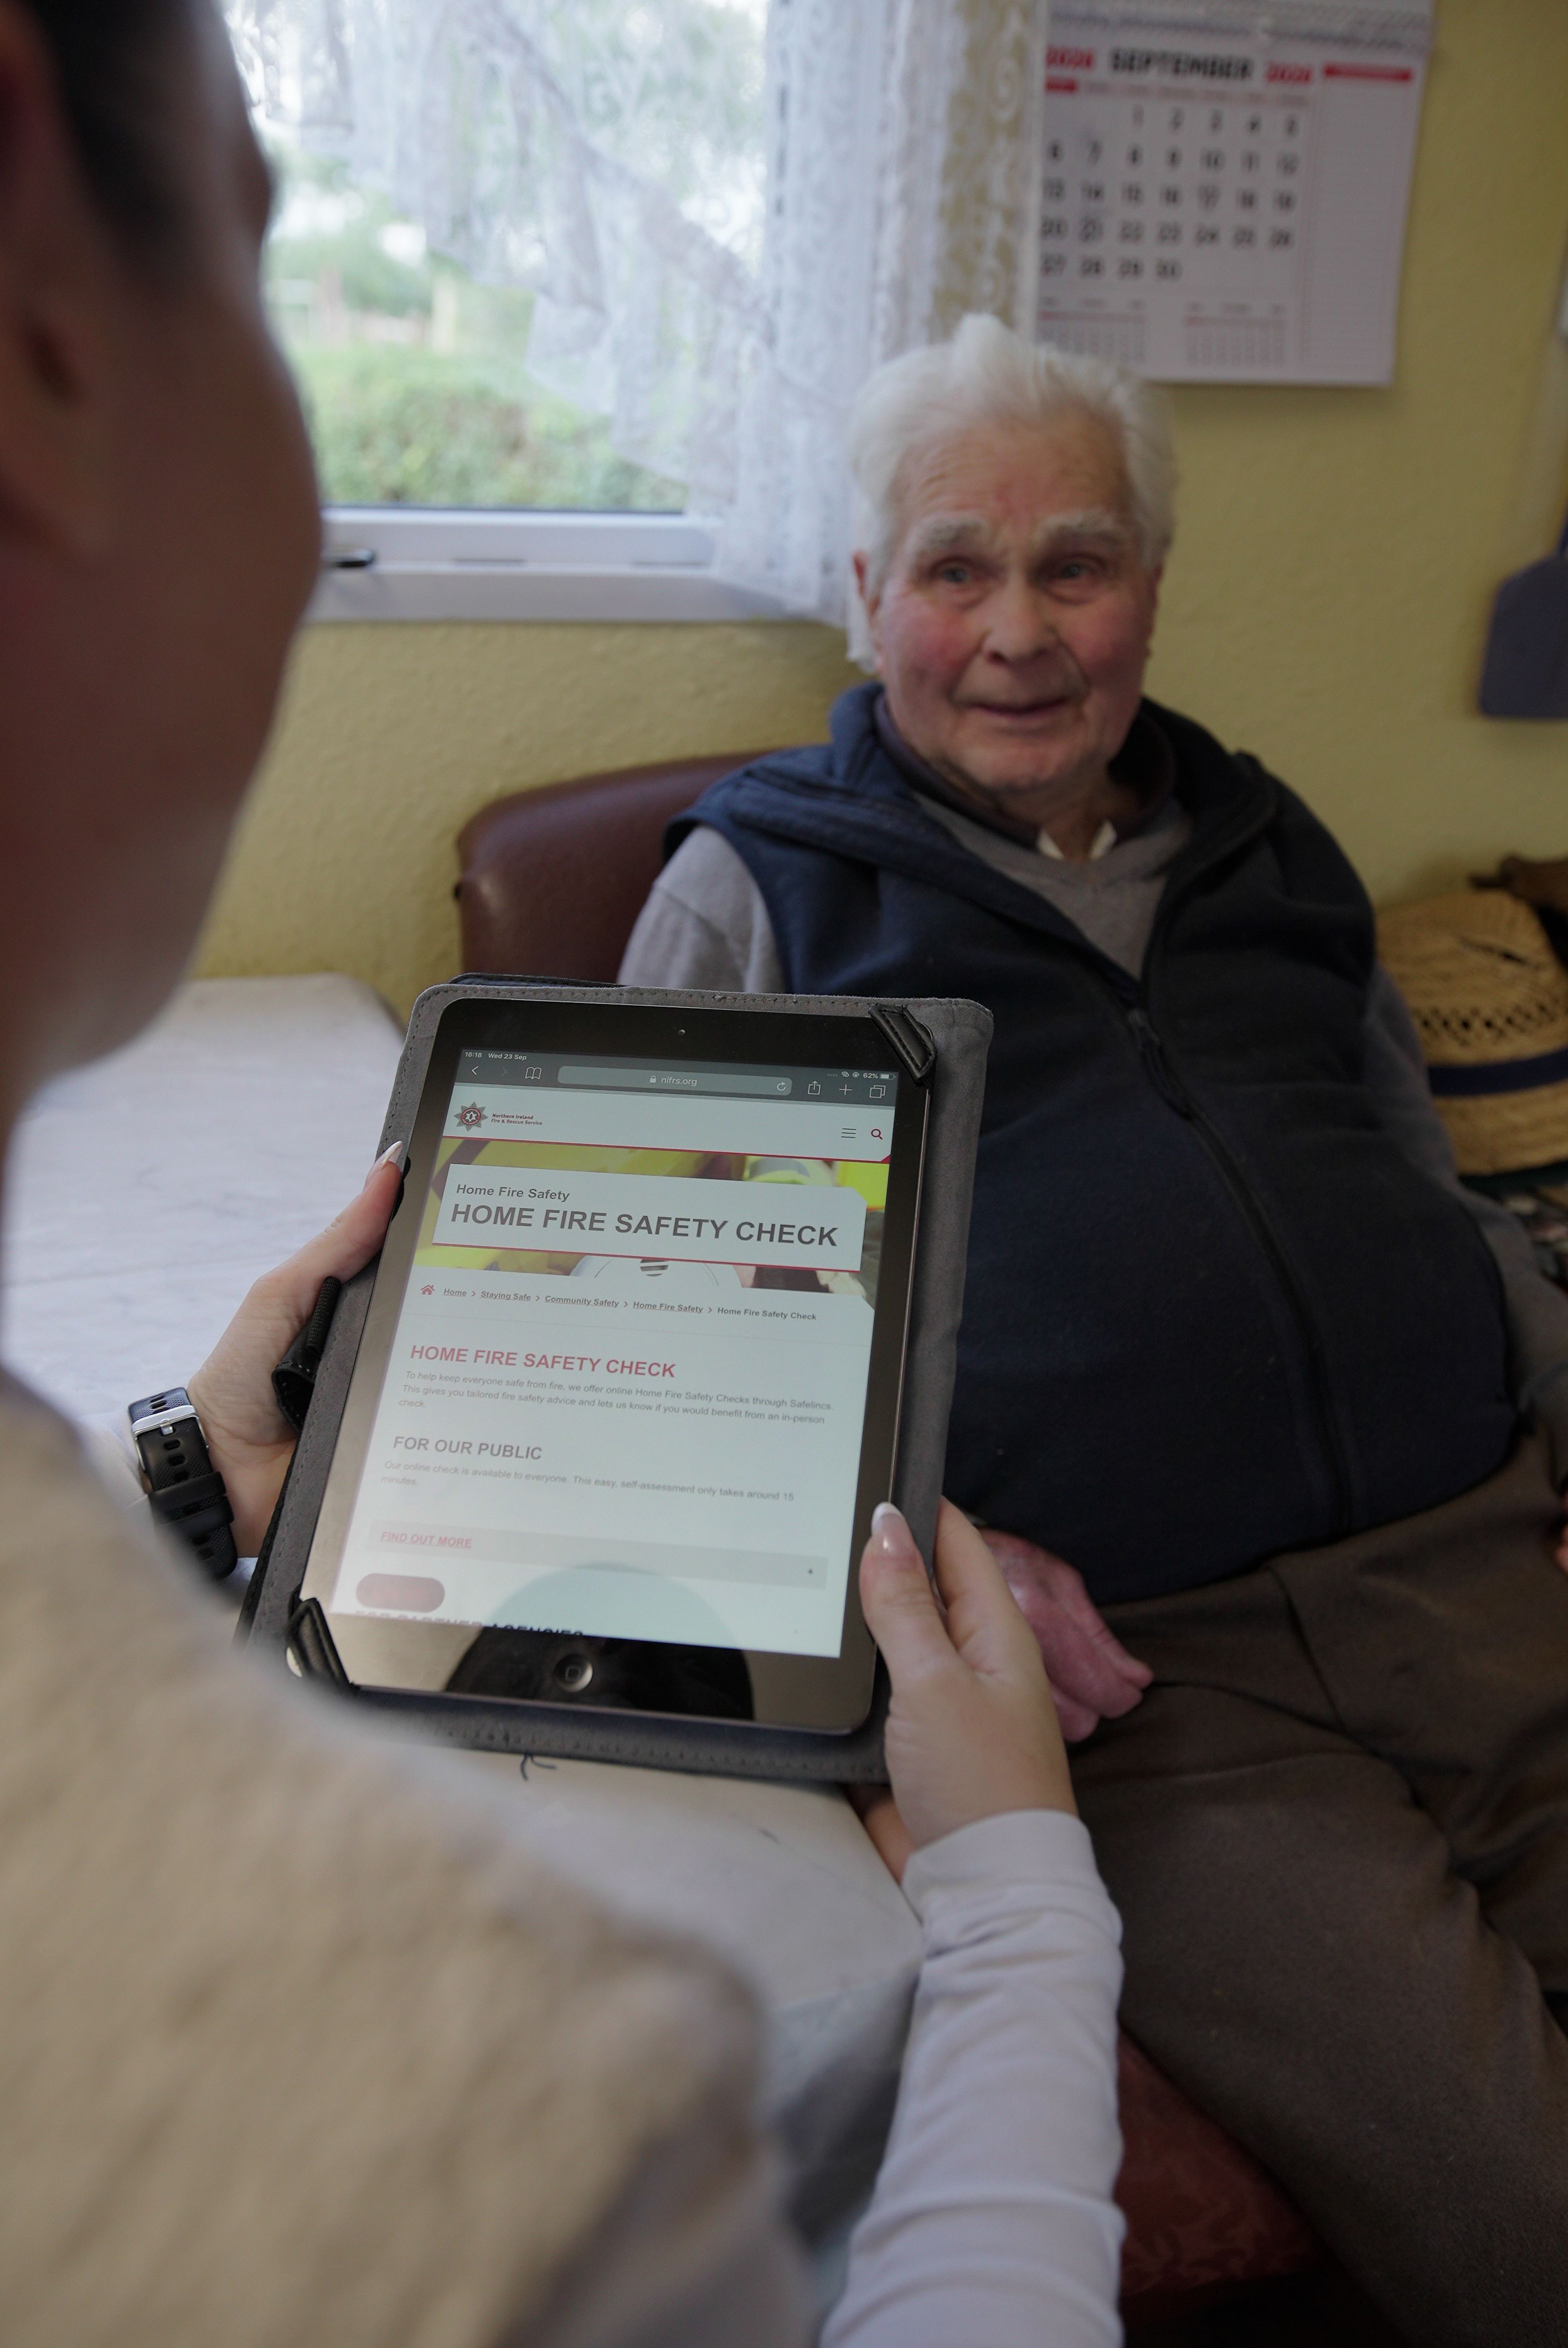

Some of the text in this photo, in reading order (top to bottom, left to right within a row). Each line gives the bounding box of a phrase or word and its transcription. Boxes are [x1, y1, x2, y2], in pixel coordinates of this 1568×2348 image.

[1110, 49, 1254, 78] SEPTEMBER
[661, 1077, 698, 1087] nifrs.org
[457, 1185, 569, 1202] Home Fire Safety
[452, 1204, 837, 1245] HOME FIRE SAFETY CHECK
[481, 1291, 510, 1300] Staying
[545, 1295, 591, 1306] Community
[594, 1299, 619, 1307] Safety
[678, 1305, 703, 1313] Safety
[762, 1310, 788, 1319] Safety
[411, 1346, 675, 1377] HOME FIRE SAFETY CHECK
[399, 1399, 426, 1407] check.
[403, 1384, 420, 1393] This
[467, 1391, 499, 1399] tailored
[518, 1394, 545, 1404] safety
[597, 1399, 613, 1408] lets
[629, 1402, 653, 1410] know
[711, 1408, 742, 1417] benefit
[745, 1410, 765, 1419] from
[782, 1414, 824, 1423] in-person
[417, 1372, 436, 1381] help
[439, 1374, 460, 1383] keep
[462, 1377, 503, 1386] everyone
[549, 1382, 565, 1391] fire,
[584, 1384, 604, 1393] offer
[636, 1388, 662, 1397] Home
[665, 1390, 682, 1399] Fire
[685, 1392, 713, 1403] Safety
[716, 1394, 749, 1403] Checks
[752, 1397, 787, 1408] through
[790, 1399, 833, 1409] Safelincs.
[394, 1436, 541, 1459] FOR OUR PUBLIC
[381, 1476, 417, 1485] minutes.
[433, 1465, 459, 1474] check
[472, 1470, 511, 1478] available
[525, 1474, 570, 1483] everyone.
[573, 1475, 591, 1485] This
[594, 1479, 617, 1488] easy,
[621, 1481, 695, 1492] self-assessment
[697, 1487, 717, 1496] only
[720, 1488, 744, 1497] takes
[747, 1491, 780, 1500] around
[784, 1492, 794, 1501] 15
[381, 1532, 472, 1548] FIND OUT MORE
